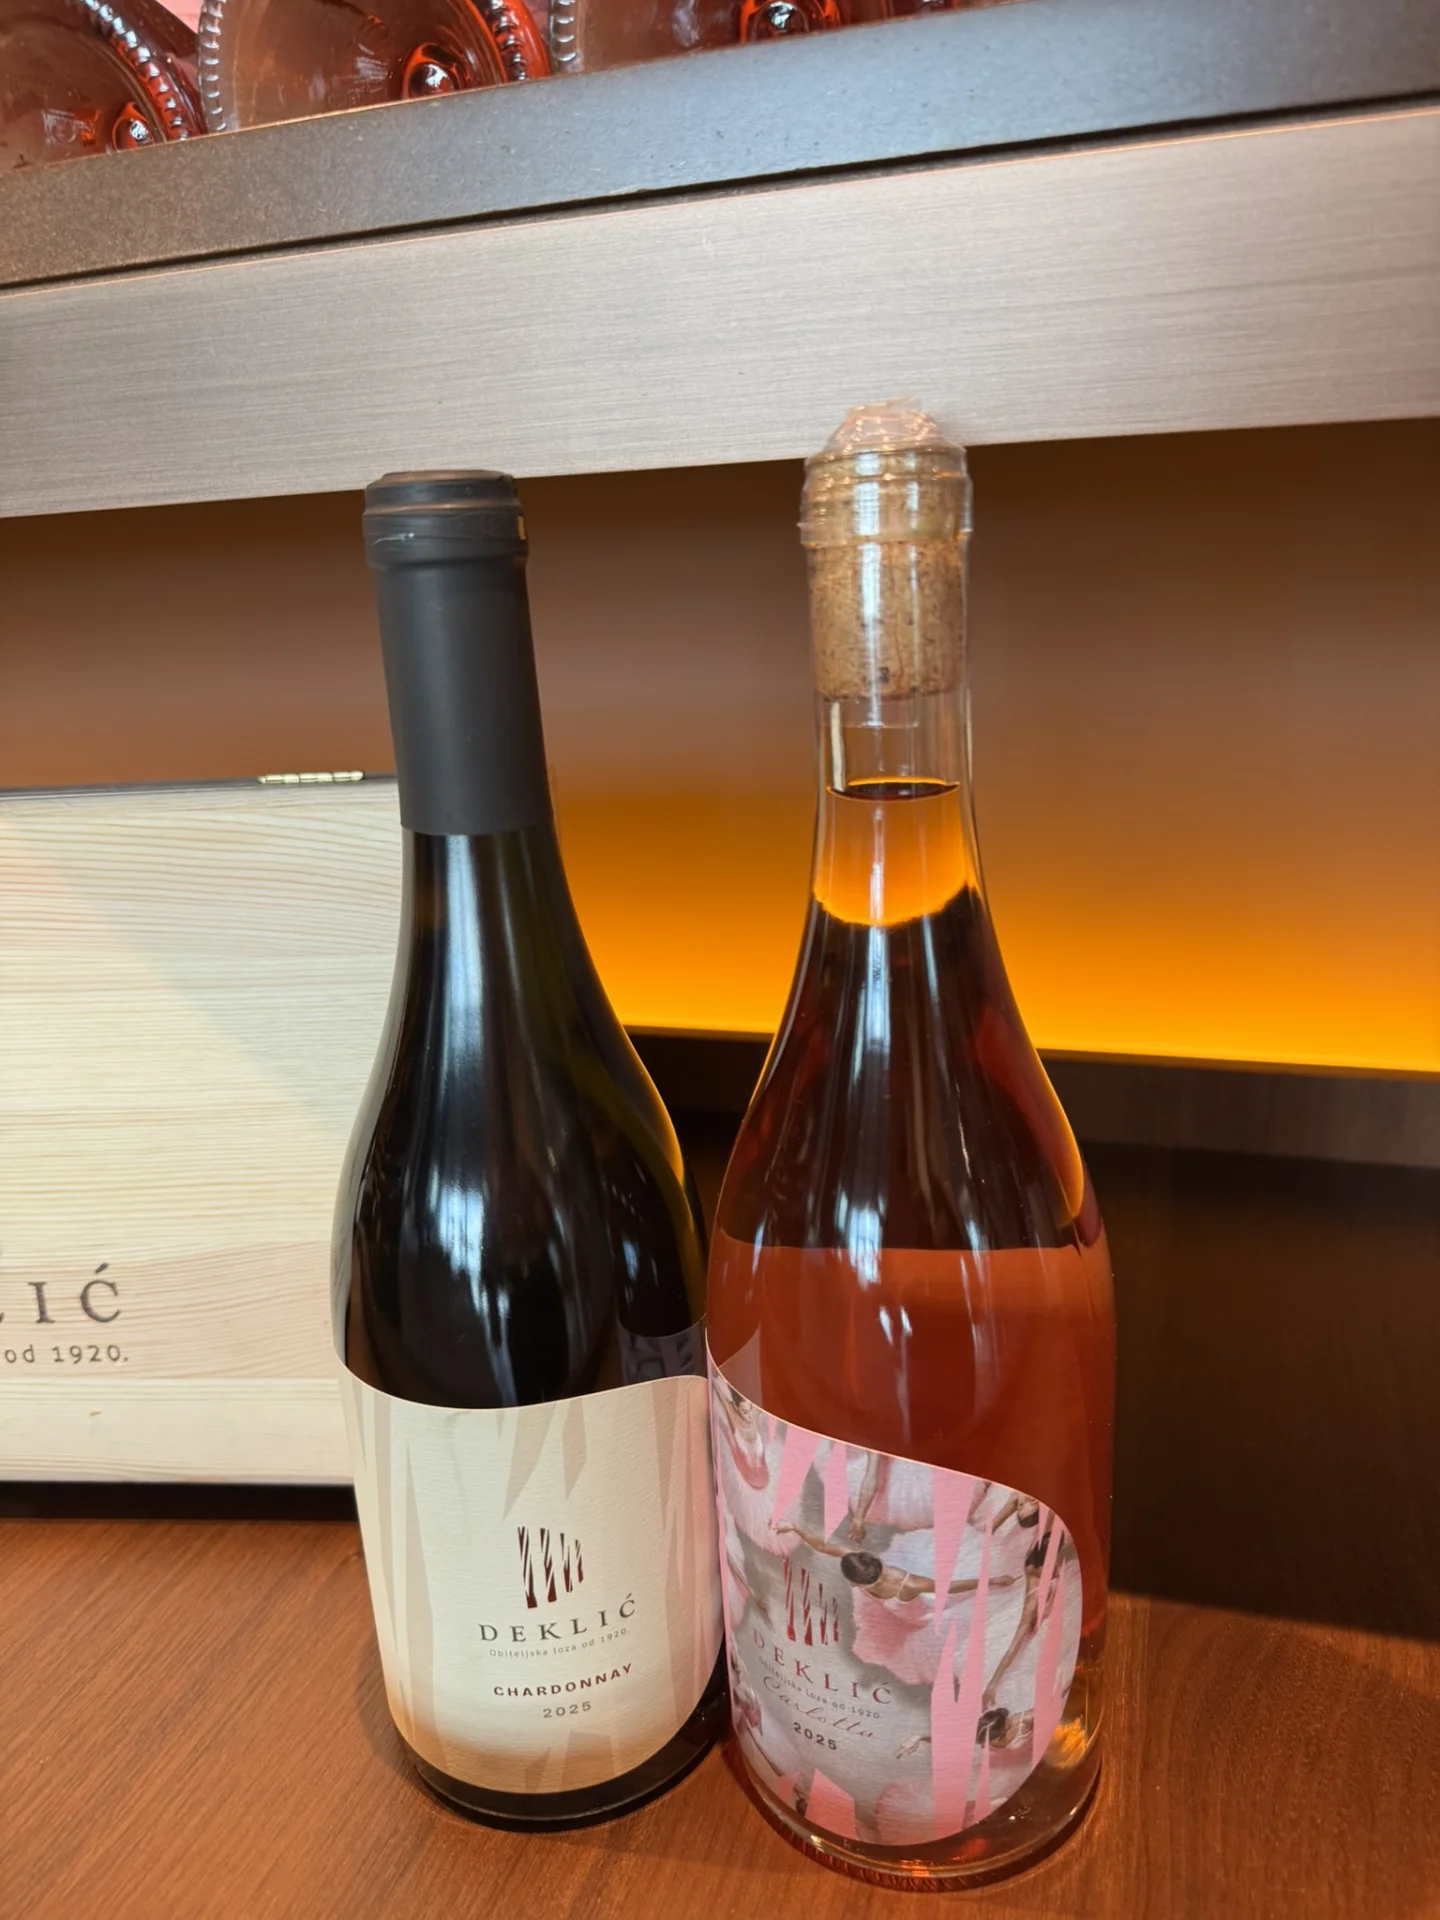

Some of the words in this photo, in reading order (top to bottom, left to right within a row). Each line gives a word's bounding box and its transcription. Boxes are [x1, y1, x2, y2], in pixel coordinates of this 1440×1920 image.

[0, 1262, 121, 1324] IĆ
[4, 1343, 36, 1364] od
[51, 1343, 129, 1365] 1920.
[478, 1592, 636, 1643] DEKLIĆ
[488, 1648, 549, 1659] Obiteljska
[553, 1644, 577, 1655] loza
[581, 1638, 596, 1649] od
[493, 1662, 632, 1697] CHARDONNAY
[752, 1627, 892, 1705] DEKLIĆ
[542, 1700, 592, 1719] 2025
[792, 1721, 838, 1751] 2025
